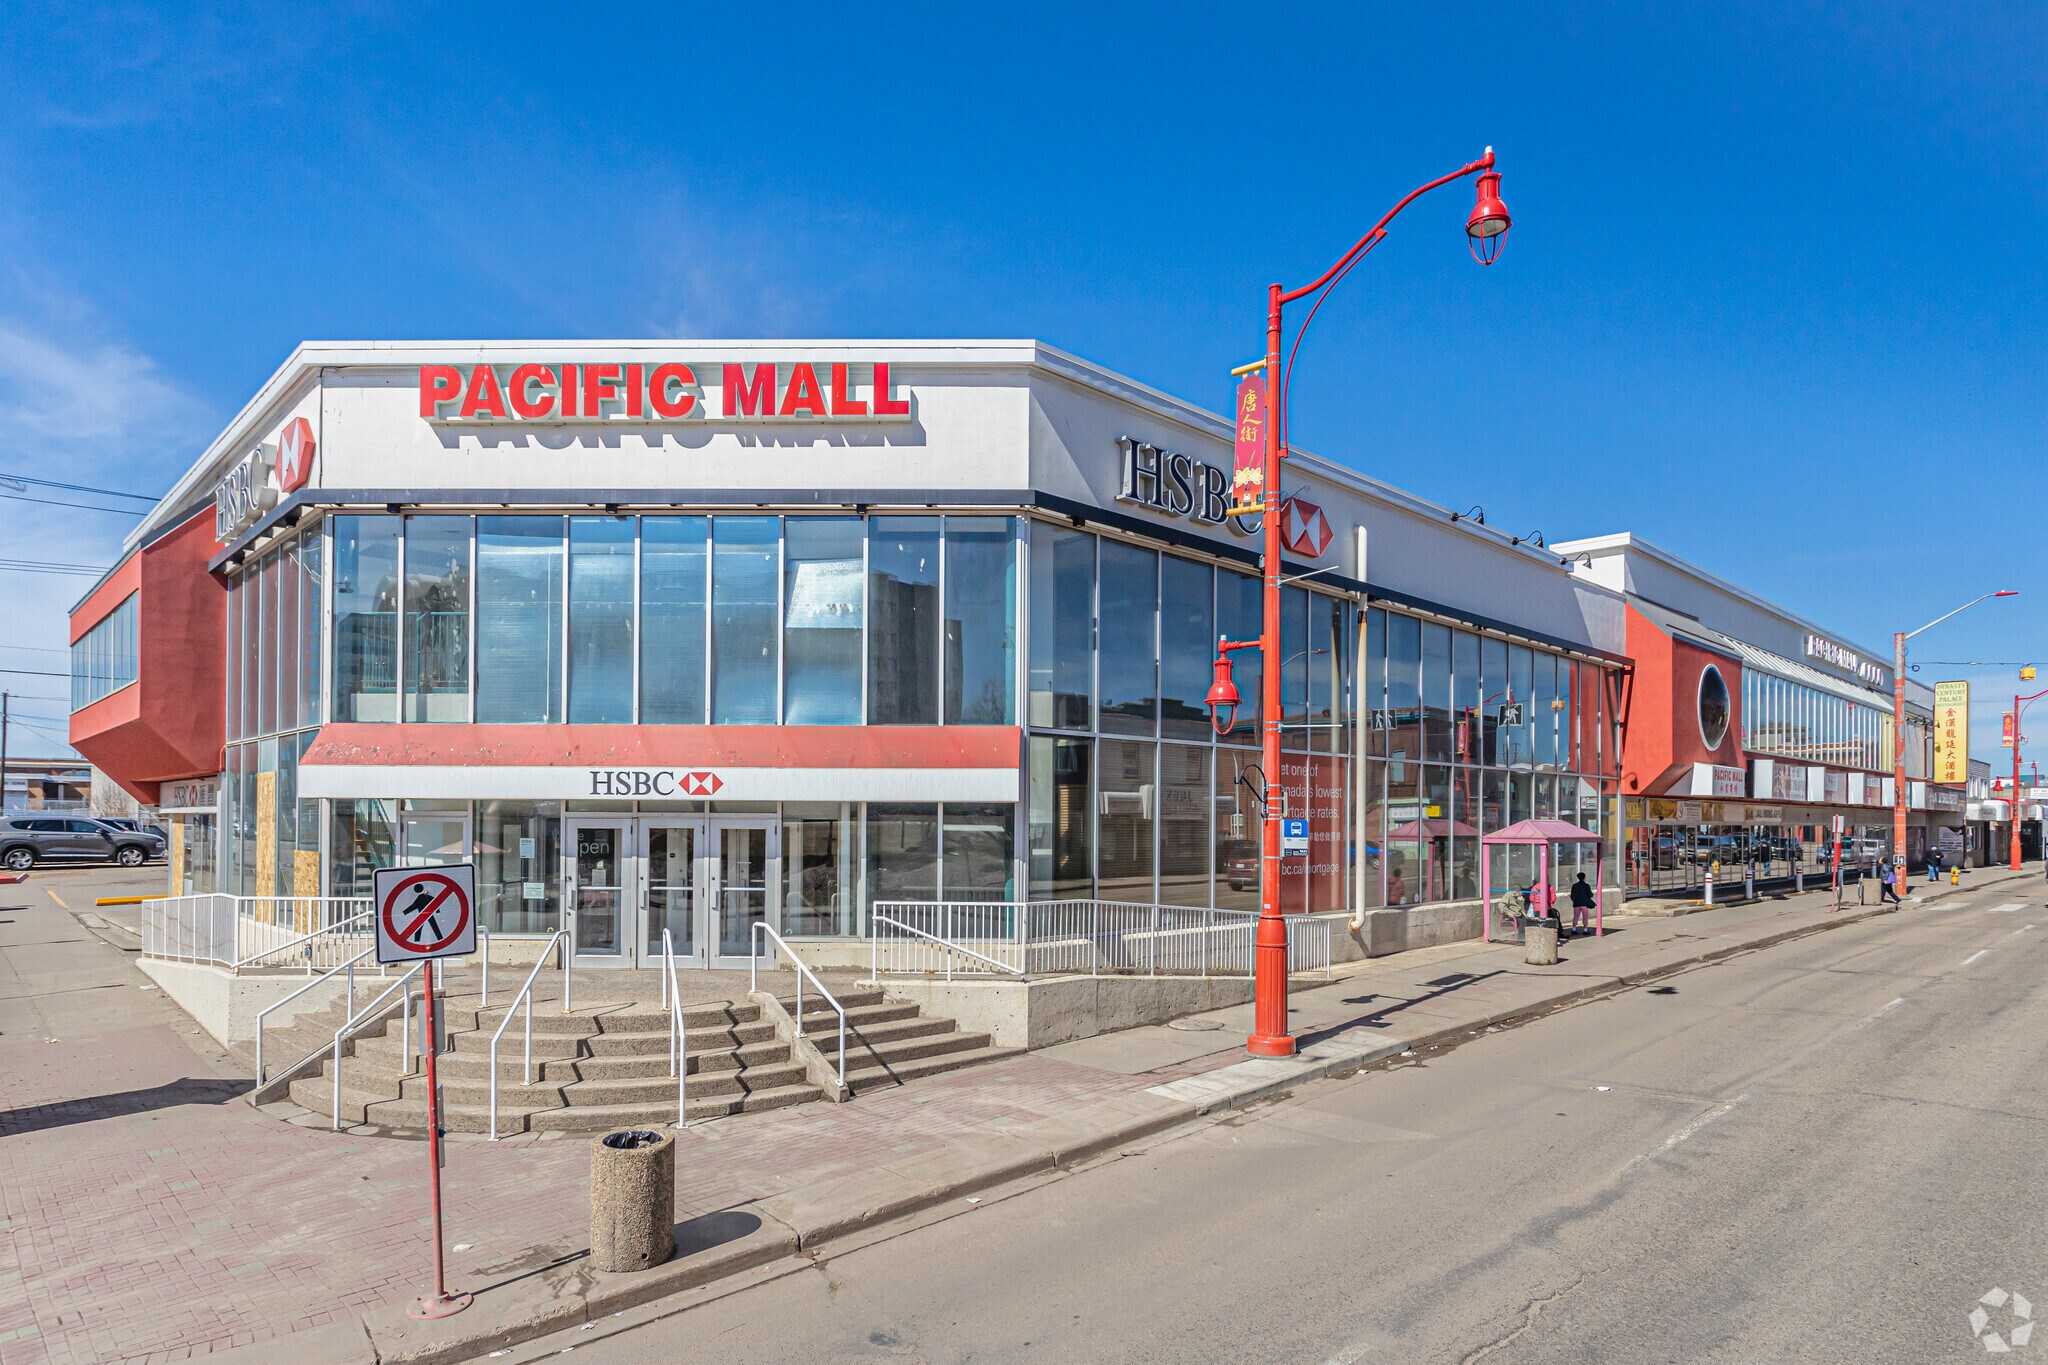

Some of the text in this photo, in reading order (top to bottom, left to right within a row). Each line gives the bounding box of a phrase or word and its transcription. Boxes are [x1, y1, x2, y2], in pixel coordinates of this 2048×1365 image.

[419, 363, 911, 419] PACIFIC MALL
[1239, 389, 1263, 442] 唐人街
[214, 444, 270, 542] HSBC
[1281, 764, 1318, 777] et one of
[1714, 769, 1743, 782] PACIFIC MALL
[590, 771, 674, 796] HSBC
[1315, 784, 1343, 799] lowest
[1317, 807, 1340, 819] rates.
[580, 842, 610, 857] pen
